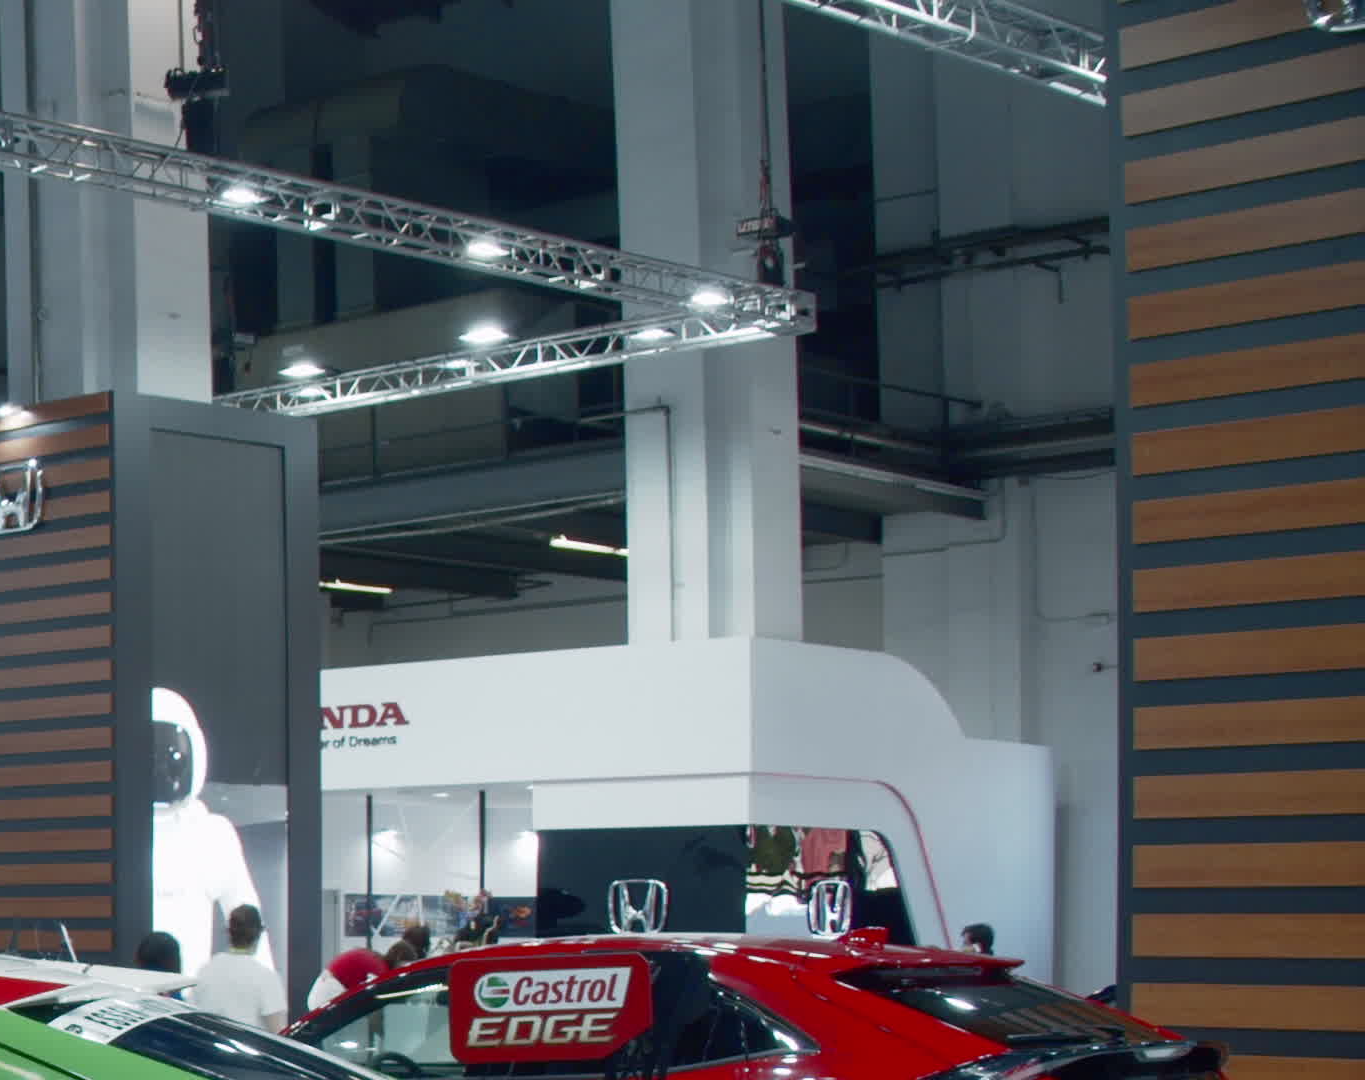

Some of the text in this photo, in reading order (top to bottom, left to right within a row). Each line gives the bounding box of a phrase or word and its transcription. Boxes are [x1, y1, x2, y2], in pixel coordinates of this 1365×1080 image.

[320, 701, 410, 730] NDA
[512, 973, 618, 1006] Castrol
[466, 1011, 619, 1048] EDGE
